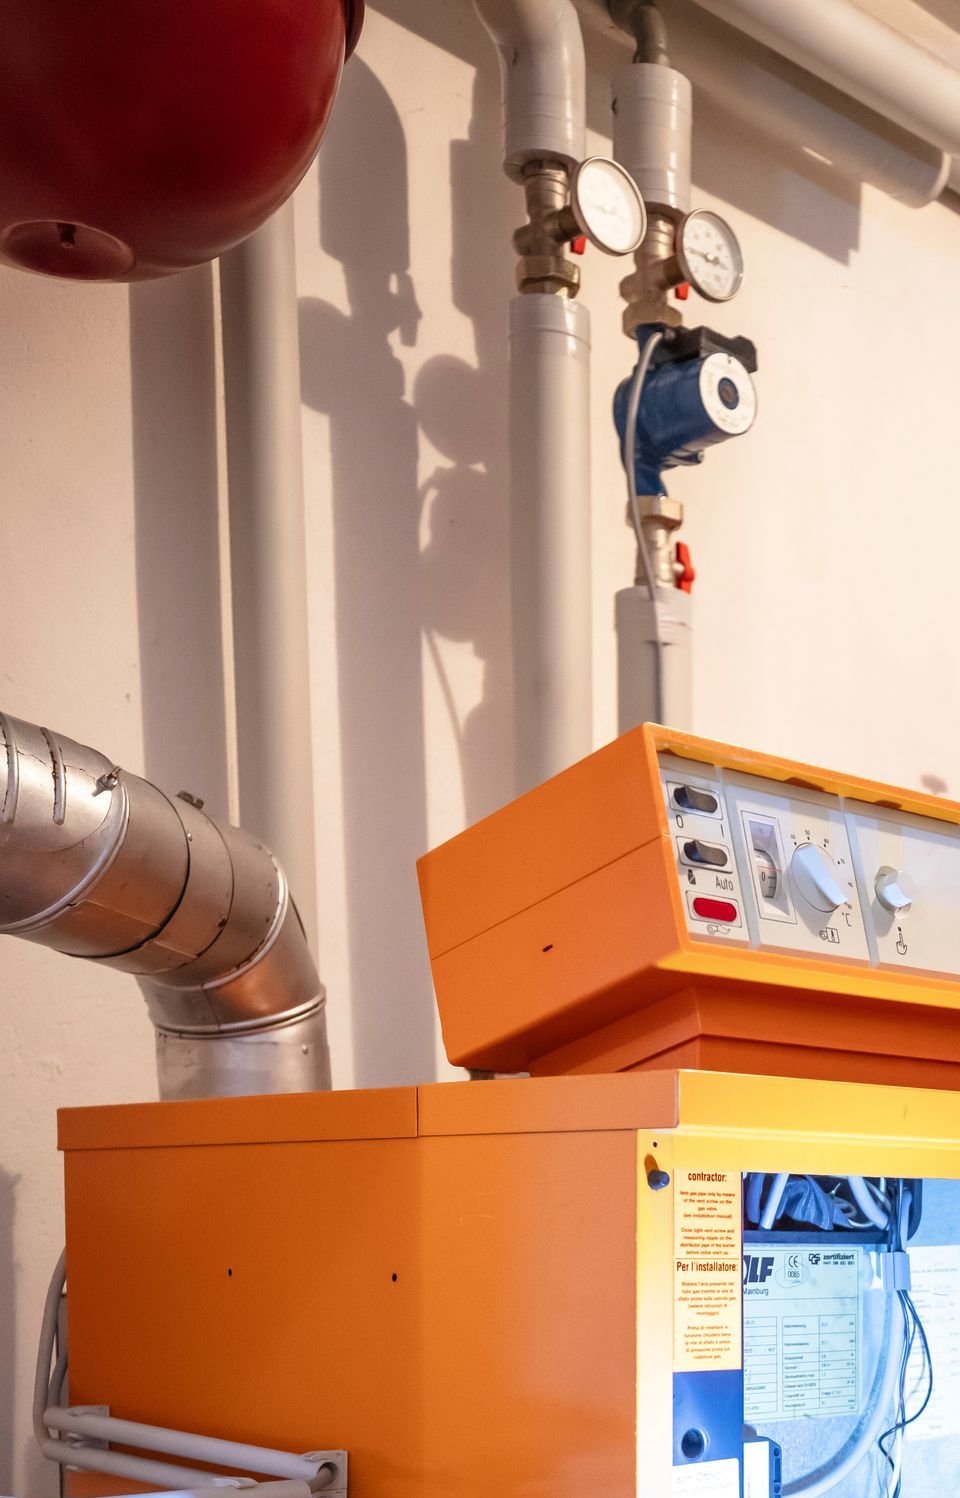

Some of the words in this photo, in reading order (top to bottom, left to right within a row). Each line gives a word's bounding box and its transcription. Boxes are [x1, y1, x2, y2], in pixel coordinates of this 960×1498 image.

[715, 875, 734, 892] Auto
[687, 1172, 727, 1182] contractor:
[676, 1261, 689, 1272] Per
